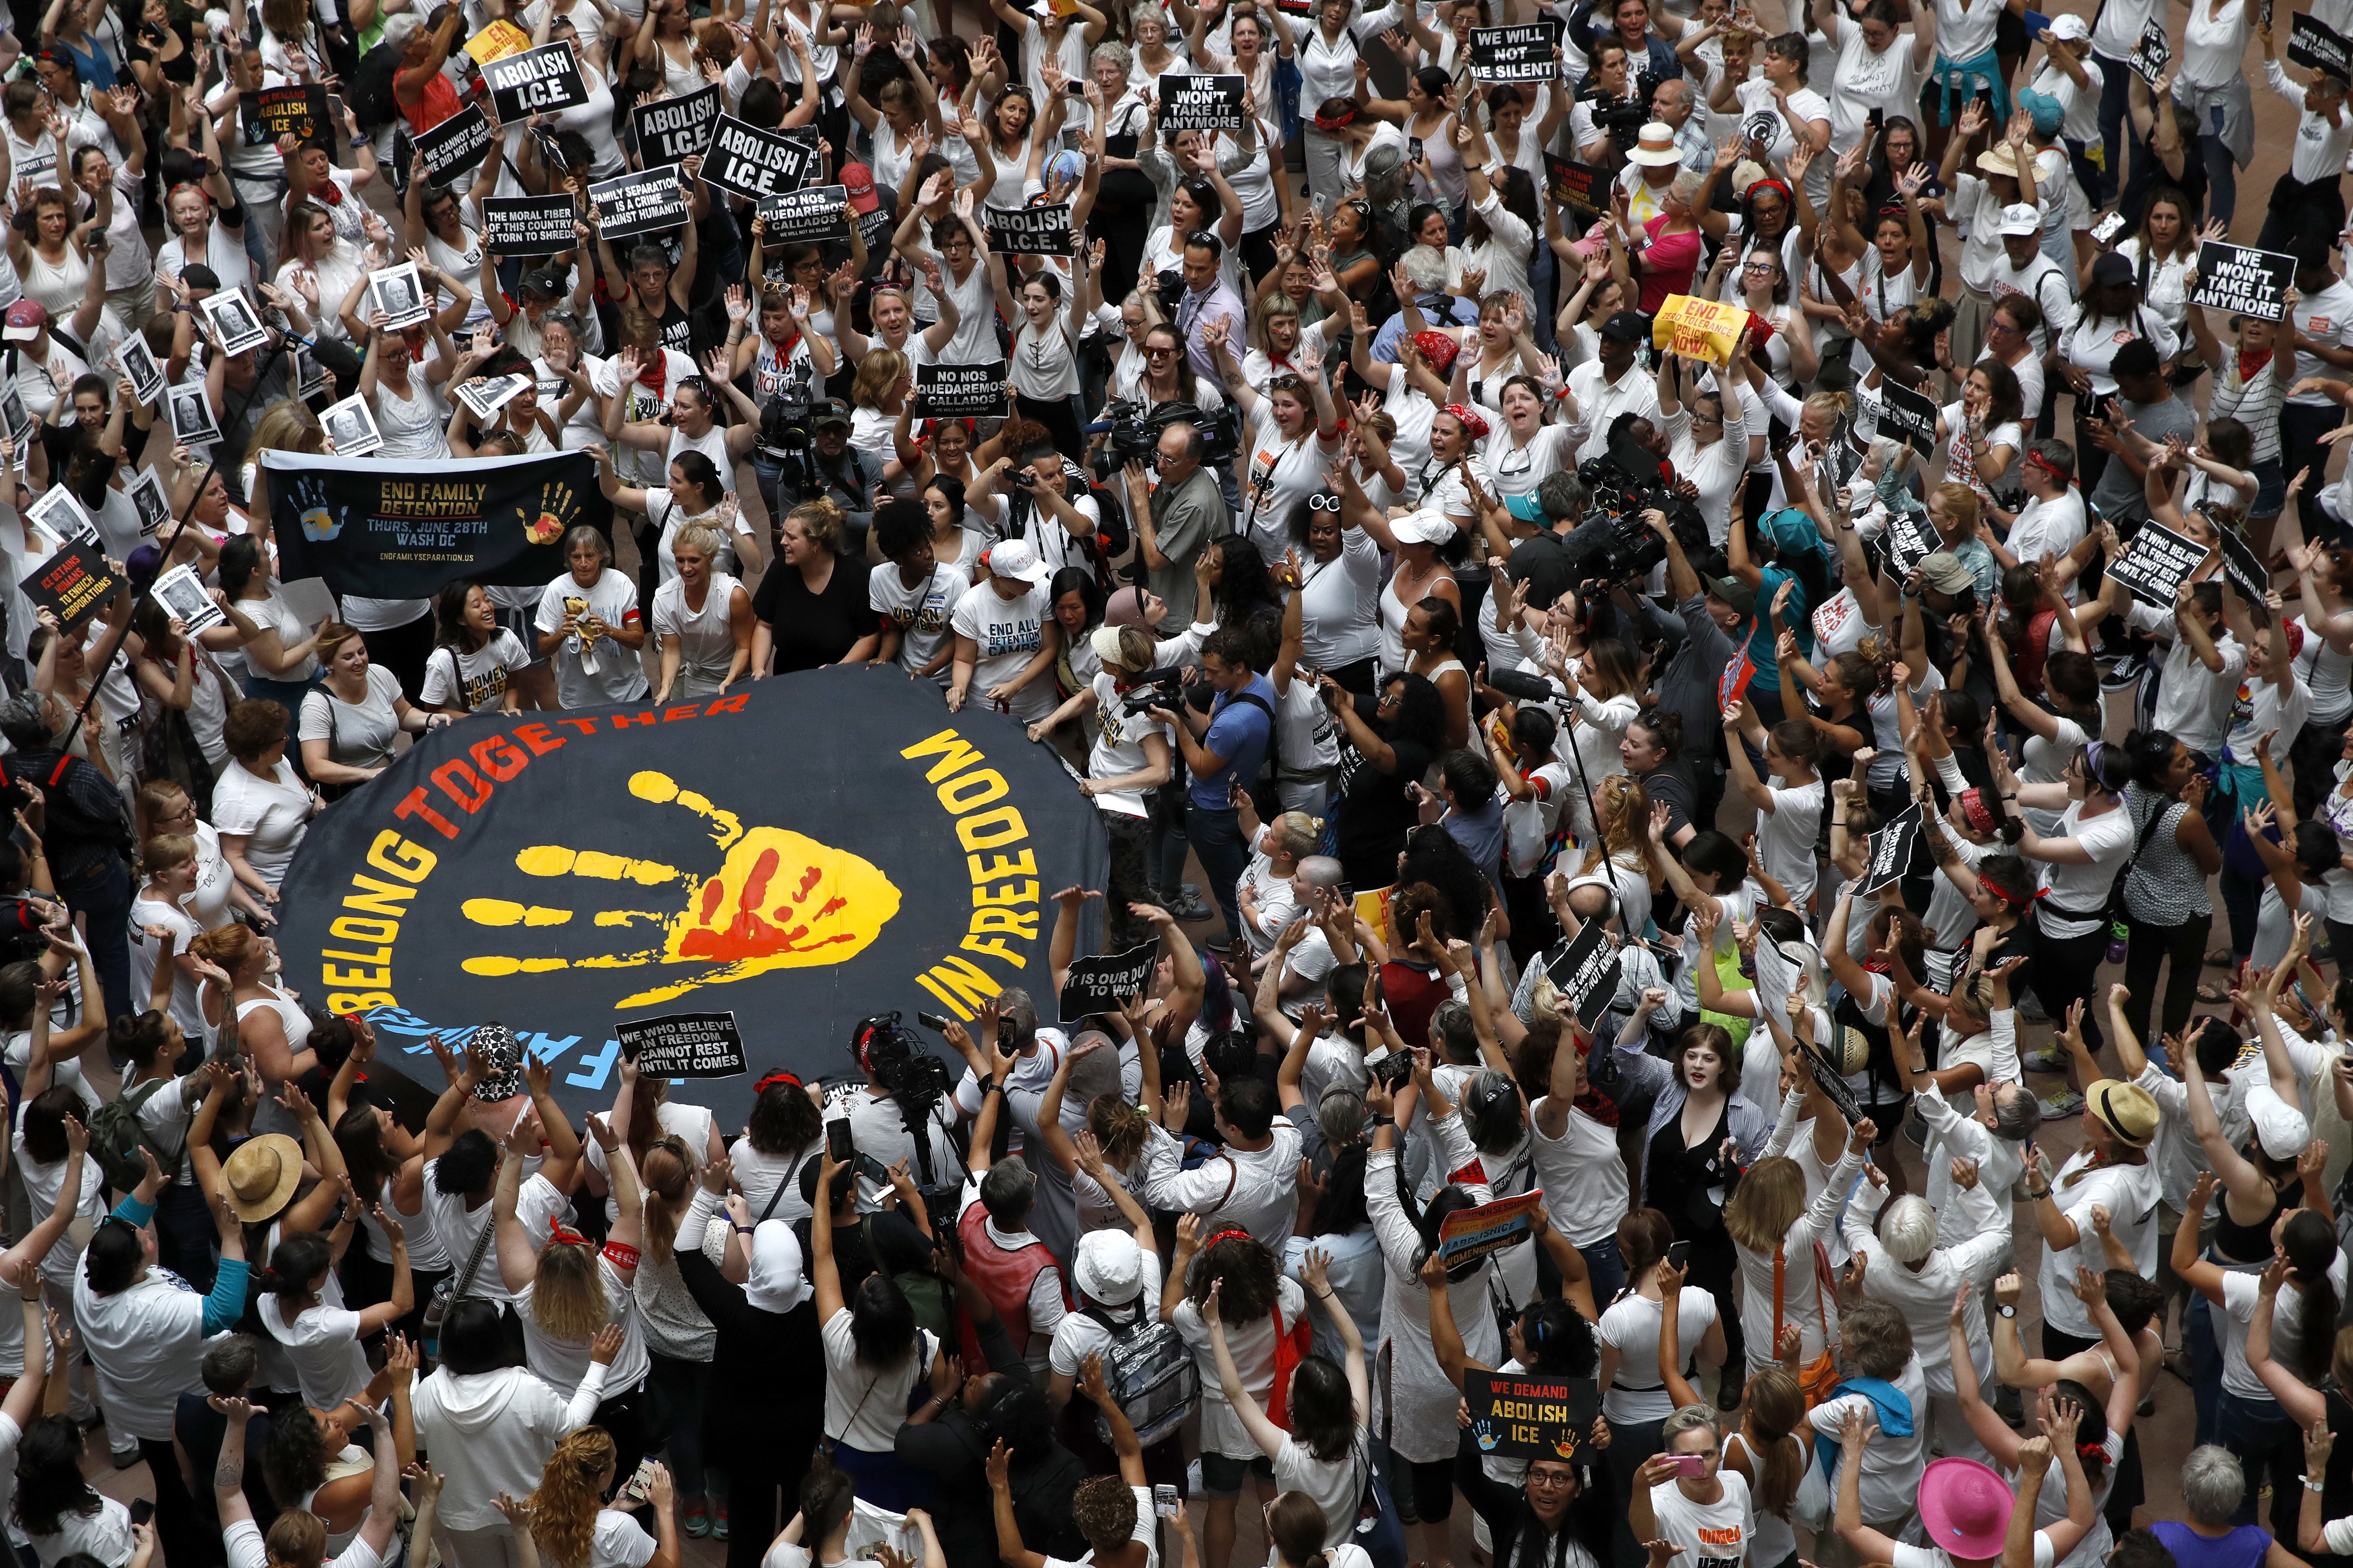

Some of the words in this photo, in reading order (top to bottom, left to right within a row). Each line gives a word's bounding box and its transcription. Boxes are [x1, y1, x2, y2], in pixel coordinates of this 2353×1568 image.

[1478, 31, 1501, 46] WE
[1506, 28, 1545, 44] WILL
[1494, 46, 1528, 61] NOT
[494, 51, 571, 90] ABOLISH
[1471, 65, 1492, 79] BE
[1496, 61, 1553, 78] SILENT
[517, 78, 571, 110] I.C.E.
[1190, 77, 1214, 91] WE
[258, 95, 271, 105] WE
[272, 91, 306, 101] DEMAND
[1176, 91, 1227, 105] WON'T
[259, 102, 308, 118] ABOLISH
[644, 93, 715, 136] ABOLISH
[1171, 104, 1212, 116] TAKE
[1217, 105, 1232, 115] IT
[272, 118, 290, 132] ICE
[1161, 117, 1240, 129] ANYMORE
[425, 150, 440, 163] WE
[439, 128, 469, 154] CANNOT
[471, 119, 486, 135] SAY
[440, 153, 454, 167] DID
[454, 143, 470, 160] NOT
[469, 126, 493, 153] KNOW
[662, 124, 711, 157] I.C.E.
[718, 126, 800, 176] ABOLISH
[592, 188, 623, 204] FAMILY
[625, 176, 679, 197] SEPARATION
[778, 196, 796, 207] NO
[799, 193, 826, 205] NOS
[615, 201, 625, 212] IS
[627, 200, 634, 210] A
[634, 192, 664, 207] CRIME
[761, 201, 847, 222] QUEDAREMOS
[488, 212, 507, 222] THE
[509, 210, 542, 221] MORAL
[544, 208, 572, 219] FIBER
[598, 212, 637, 229] AGAINST
[639, 200, 685, 221] HUMANITY
[772, 214, 837, 231] CALLADOS
[986, 209, 1072, 232] ABOLISH
[488, 222, 500, 233] OF
[503, 222, 526, 232] THIS
[528, 219, 572, 230] COUNTRY
[497, 232, 523, 243] TORN
[525, 231, 537, 242] TO
[539, 230, 577, 240] SHREDS
[1005, 233, 1058, 250] I.C.E.
[2235, 249, 2262, 268] WE
[2216, 261, 2273, 285] WON'T
[2208, 275, 2253, 297] TAKE
[2256, 285, 2276, 301] IT
[1685, 300, 1719, 320] END
[2193, 289, 2281, 318] ANYMORE
[666, 321, 690, 341] AND
[1661, 312, 1682, 321] ZERO
[1684, 315, 1734, 337] TOLERANCE
[1676, 324, 1707, 339] POLICY
[1673, 334, 1710, 356] NOW!
[937, 371, 956, 382] NO
[961, 371, 987, 382] NOS
[918, 381, 1007, 395] QUEDAREMOS
[928, 394, 997, 406] CALLADOS
[367, 437, 378, 446] Hate
[381, 481, 414, 499] END
[421, 483, 486, 500] FAMILY
[32, 505, 45, 518] Kevin
[44, 488, 64, 507] McCarthy
[381, 500, 479, 516] DETENTION
[367, 519, 412, 533] THURS,
[417, 522, 450, 533] JUNE
[454, 522, 488, 533] 28TH
[396, 533, 434, 546] WASH
[439, 534, 456, 546] DC
[1901, 520, 1915, 538] OUR
[1909, 536, 1930, 556] DUTY
[2137, 527, 2149, 542] WE
[2148, 531, 2169, 551] WHO
[2168, 541, 2203, 567] BELIEVE
[380, 552, 474, 562] ENDFAMILYSEPARATION.US
[2136, 541, 2148, 556] IN
[2148, 548, 2187, 572] FREEDOM
[41, 577, 54, 590] ICE
[50, 555, 81, 582] DETAINS
[2128, 551, 2161, 575] CANNOT
[2159, 566, 2182, 585] REST
[54, 567, 86, 594] HUMANS
[152, 581, 167, 593] Kevin
[167, 568, 189, 584] McCarthy
[2115, 560, 2138, 580] UNTIL
[2137, 571, 2149, 583] IT
[2148, 579, 2177, 599] COMES
[59, 594, 72, 606] TO
[68, 574, 96, 597] ENRICH
[61, 576, 112, 621] CORPORATIONS
[891, 605, 940, 622] WOMEN
[989, 623, 1013, 636] END
[1018, 618, 1038, 634] ALL
[990, 631, 1040, 645] DETENTION
[465, 664, 508, 693] WOMEN
[393, 693, 751, 840] TOGETHER
[900, 728, 1040, 969] FREEDOM
[1881, 821, 1907, 876] DEPORTATIONS
[204, 857, 214, 866] I
[204, 873, 216, 887] DO
[322, 829, 437, 1016] BELONG
[1564, 978, 1579, 997] WE
[1575, 949, 1599, 985] CANNOT
[1597, 935, 1609, 956] SAY
[914, 954, 1004, 1023] IN
[1064, 974, 1078, 990] IT
[1080, 974, 1095, 985] IS
[1098, 970, 1128, 984] OUR
[1090, 985, 1107, 997] TO
[1113, 982, 1139, 997] WIN
[1570, 995, 1582, 1015] WE
[1579, 983, 1589, 1002] DID
[1589, 967, 1602, 991] NOT
[1597, 947, 1619, 975] KNOW
[621, 1030, 643, 1044] WE
[643, 1023, 676, 1038] WHO
[678, 1021, 734, 1033] BELIEVE
[641, 1039, 656, 1049] IN
[659, 1032, 722, 1045] FREEDOM
[640, 1045, 692, 1061] CANNOT
[695, 1042, 729, 1056] REST
[639, 1060, 675, 1073] UNTIL
[677, 1059, 689, 1070] IT
[693, 1055, 739, 1070] COMES
[1494, 1166, 1515, 1192] DEPORT
[1144, 1378, 1158, 1391] Mitch
[1157, 1361, 1186, 1381] McConnell
[1490, 1380, 1510, 1394] WE
[1514, 1383, 1568, 1398] DEMAND
[1491, 1399, 1567, 1424] ABOLISH
[1512, 1424, 1539, 1443] ICE
